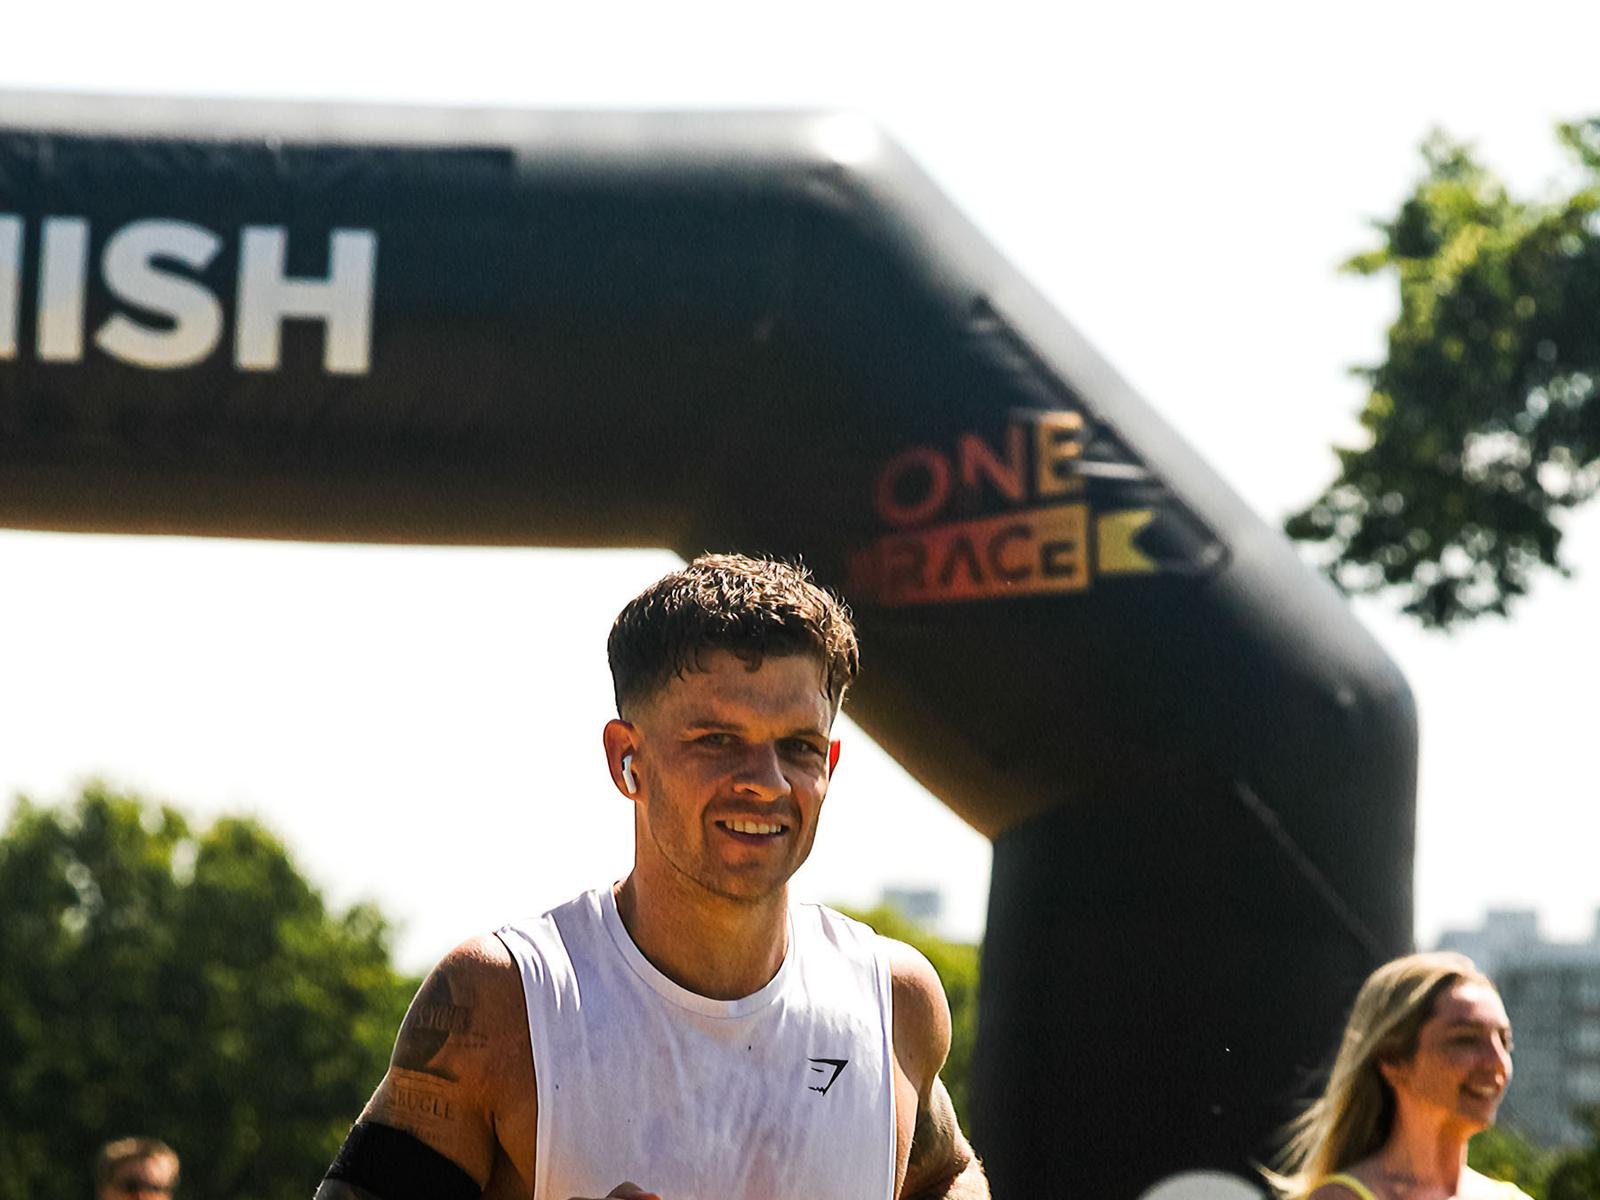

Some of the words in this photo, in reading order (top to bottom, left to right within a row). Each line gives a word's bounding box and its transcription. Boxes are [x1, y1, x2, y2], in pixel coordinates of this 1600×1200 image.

[0, 213, 379, 376] ISH
[875, 409, 1085, 526] ONE
[894, 516, 1079, 592] RACE
